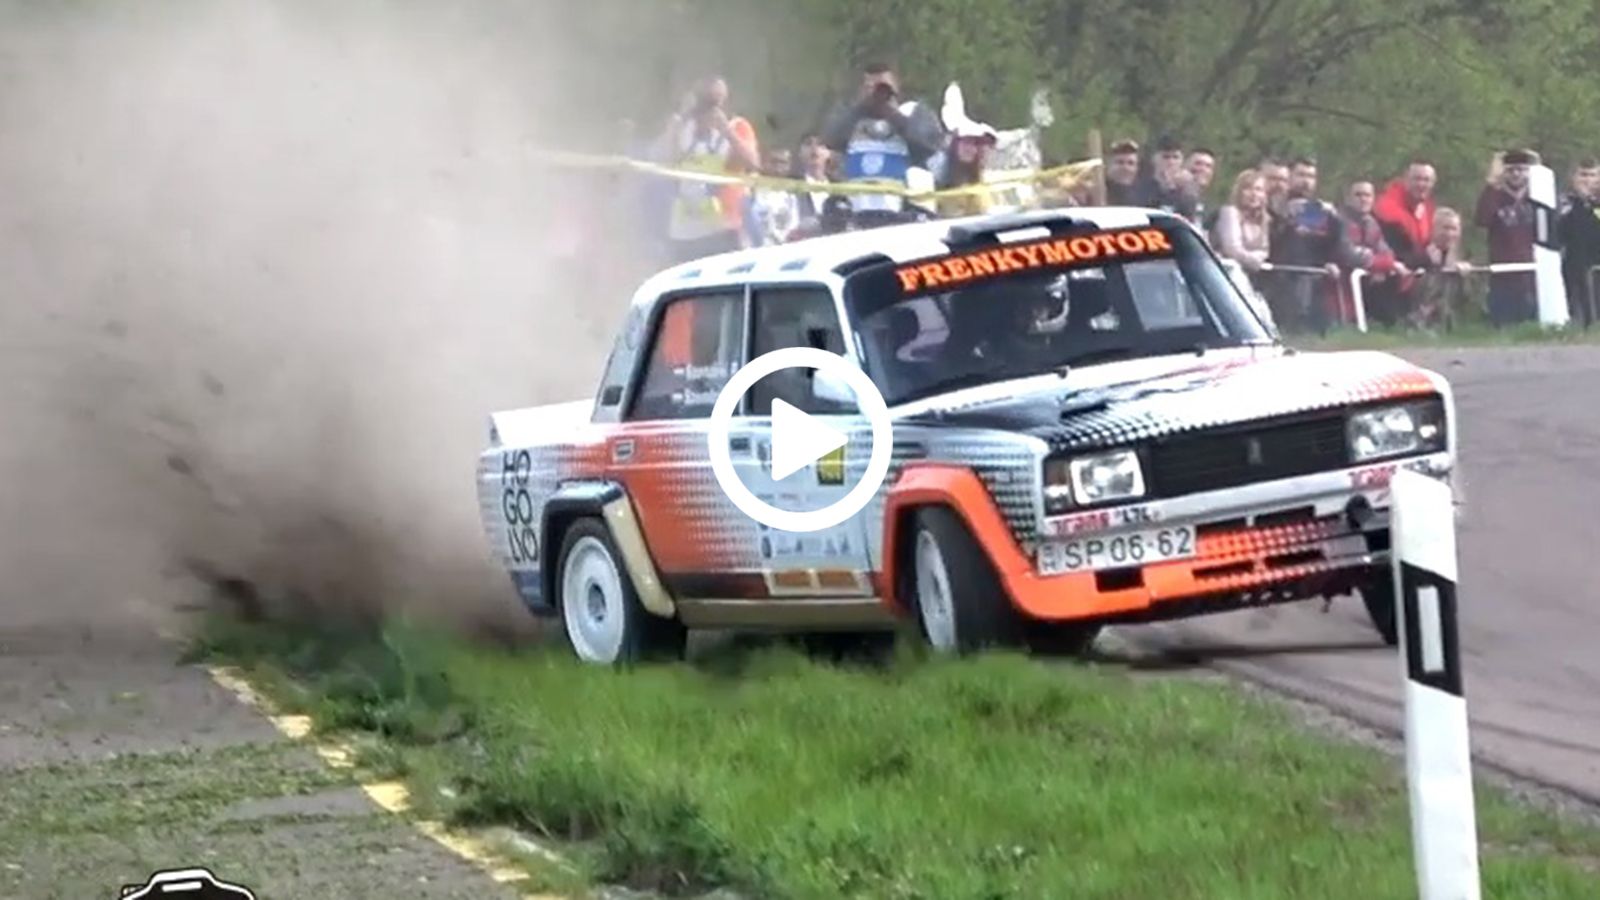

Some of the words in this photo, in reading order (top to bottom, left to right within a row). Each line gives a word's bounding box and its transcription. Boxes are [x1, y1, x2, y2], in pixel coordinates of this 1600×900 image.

[895, 228, 1171, 292] FRENKYMOTOR
[503, 488, 532, 526] GO
[1064, 540, 1104, 569] SP
[1110, 527, 1191, 561] 06-62
